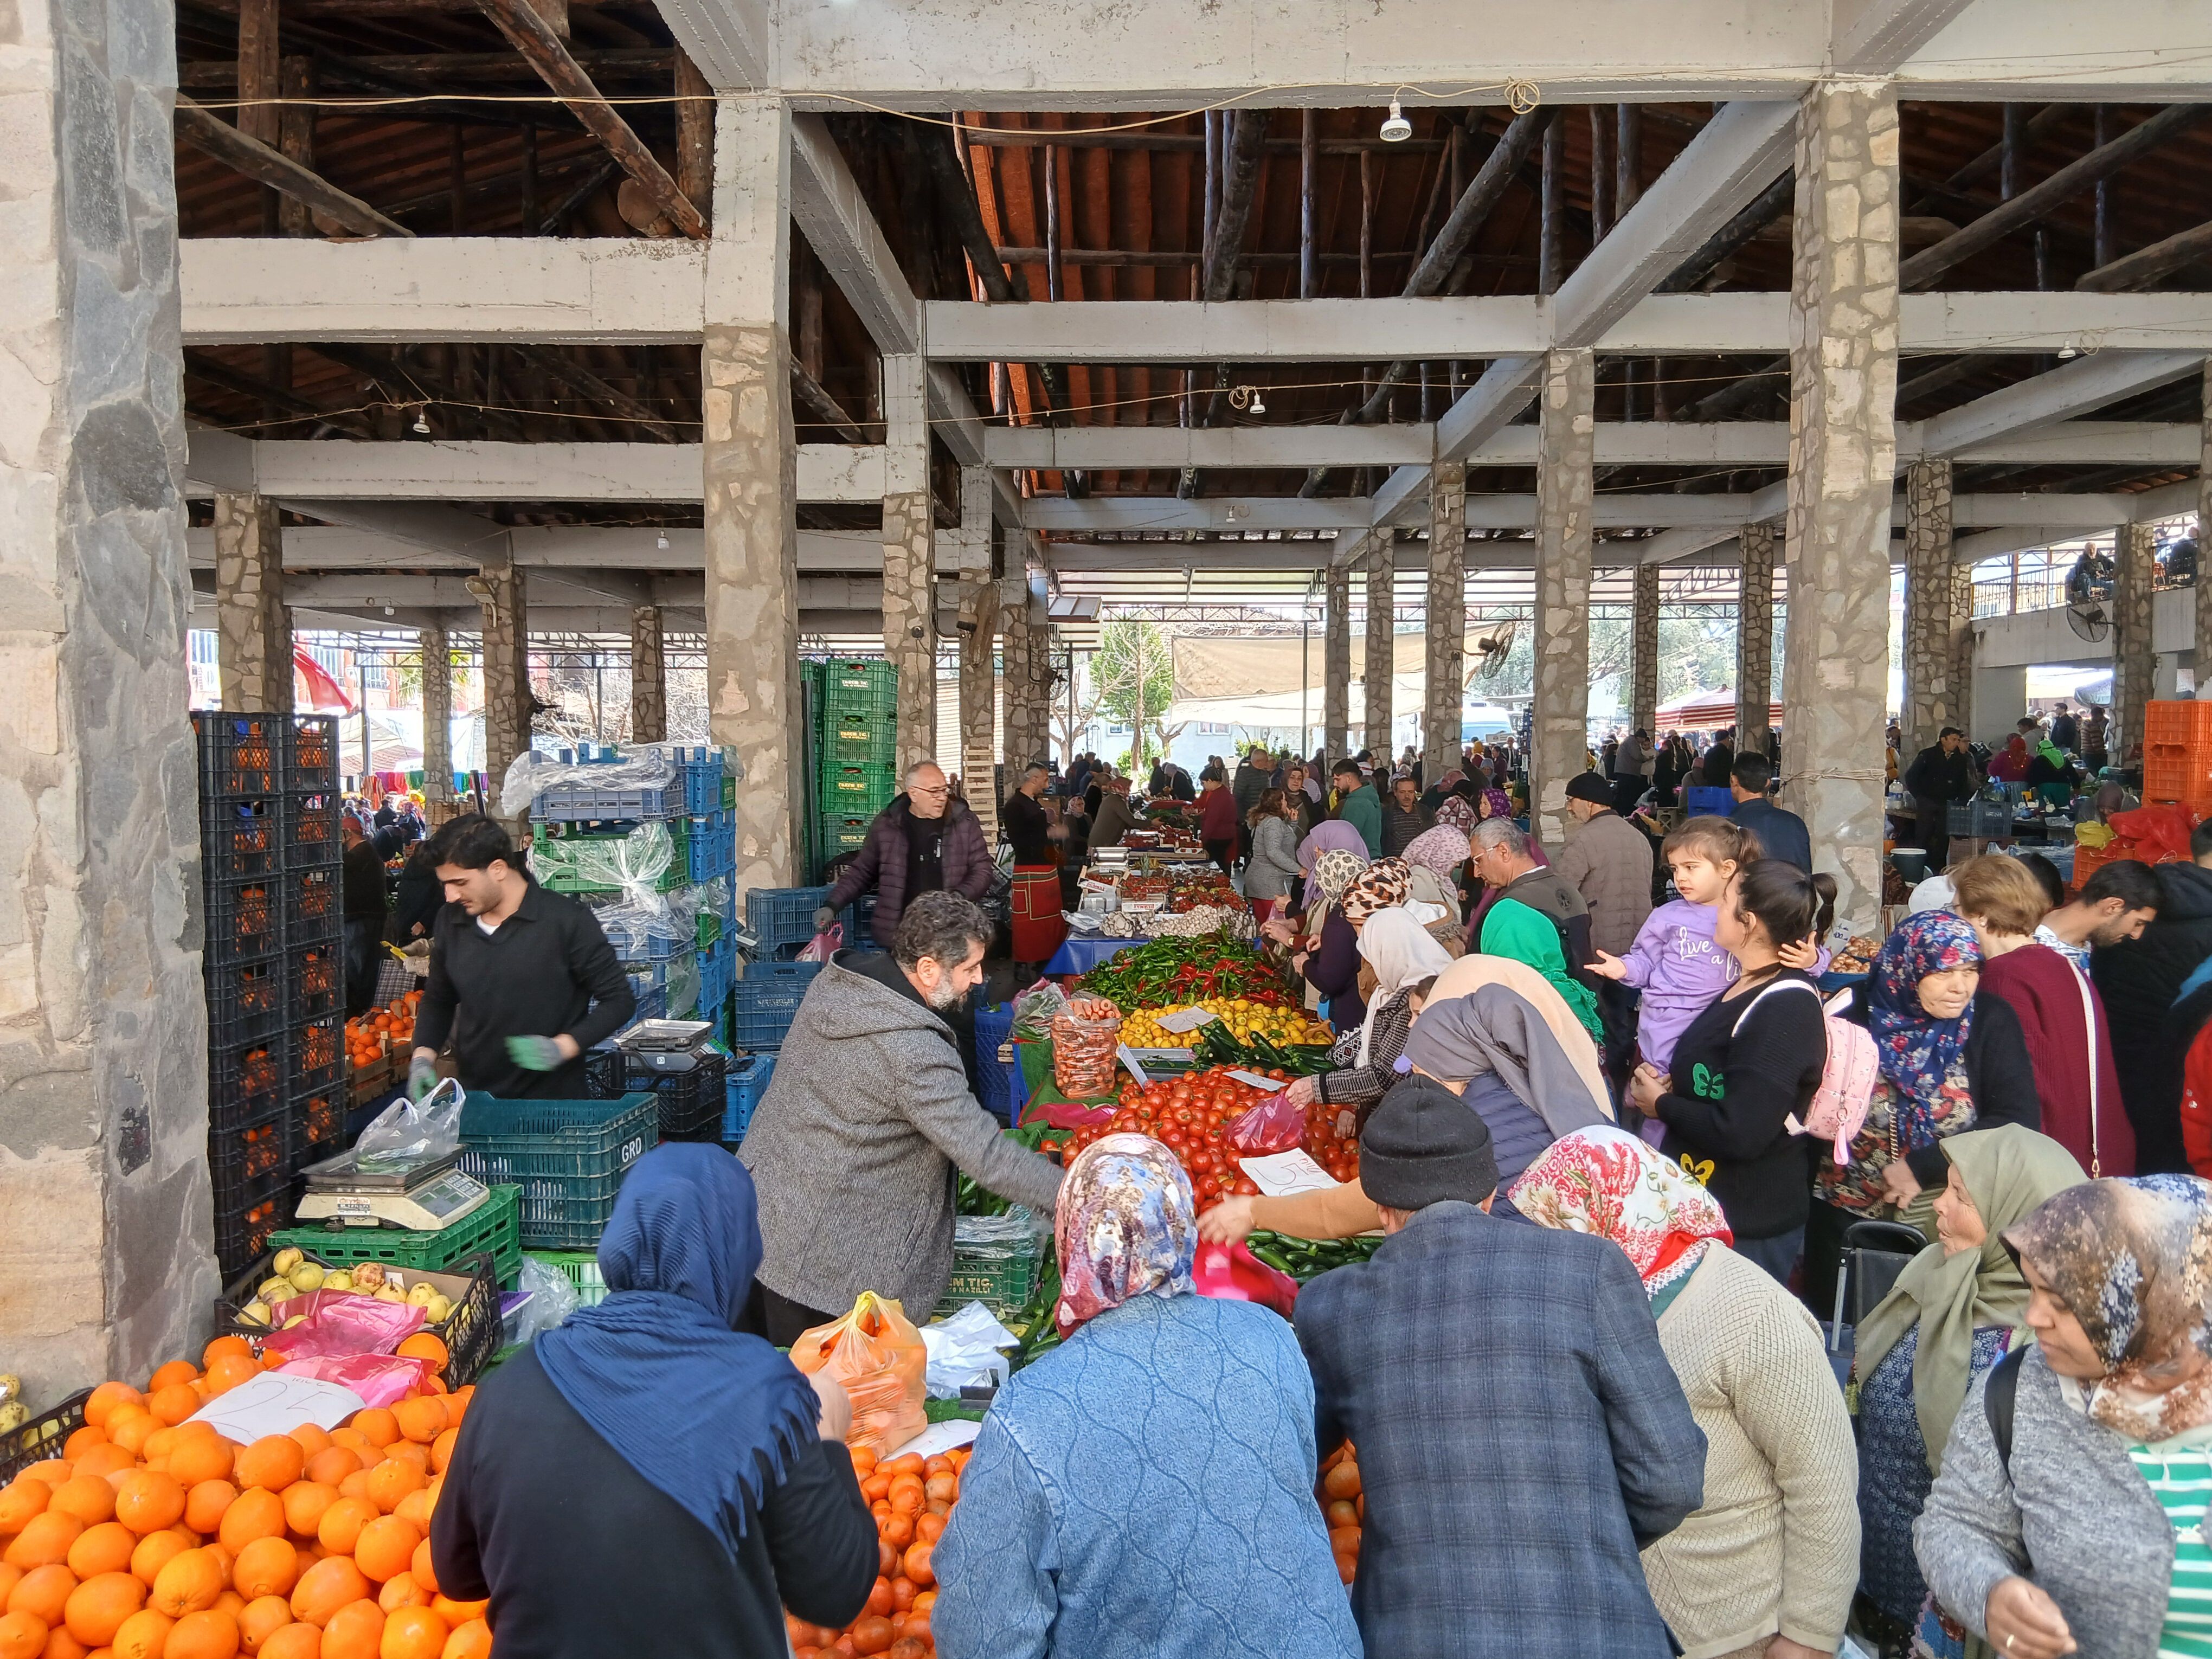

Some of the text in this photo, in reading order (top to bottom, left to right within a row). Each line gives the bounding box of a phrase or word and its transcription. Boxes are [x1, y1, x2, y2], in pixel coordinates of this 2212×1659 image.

[1678, 926, 1714, 961] Live
[1711, 954, 1724, 965] a
[621, 1136, 642, 1163] GRD
